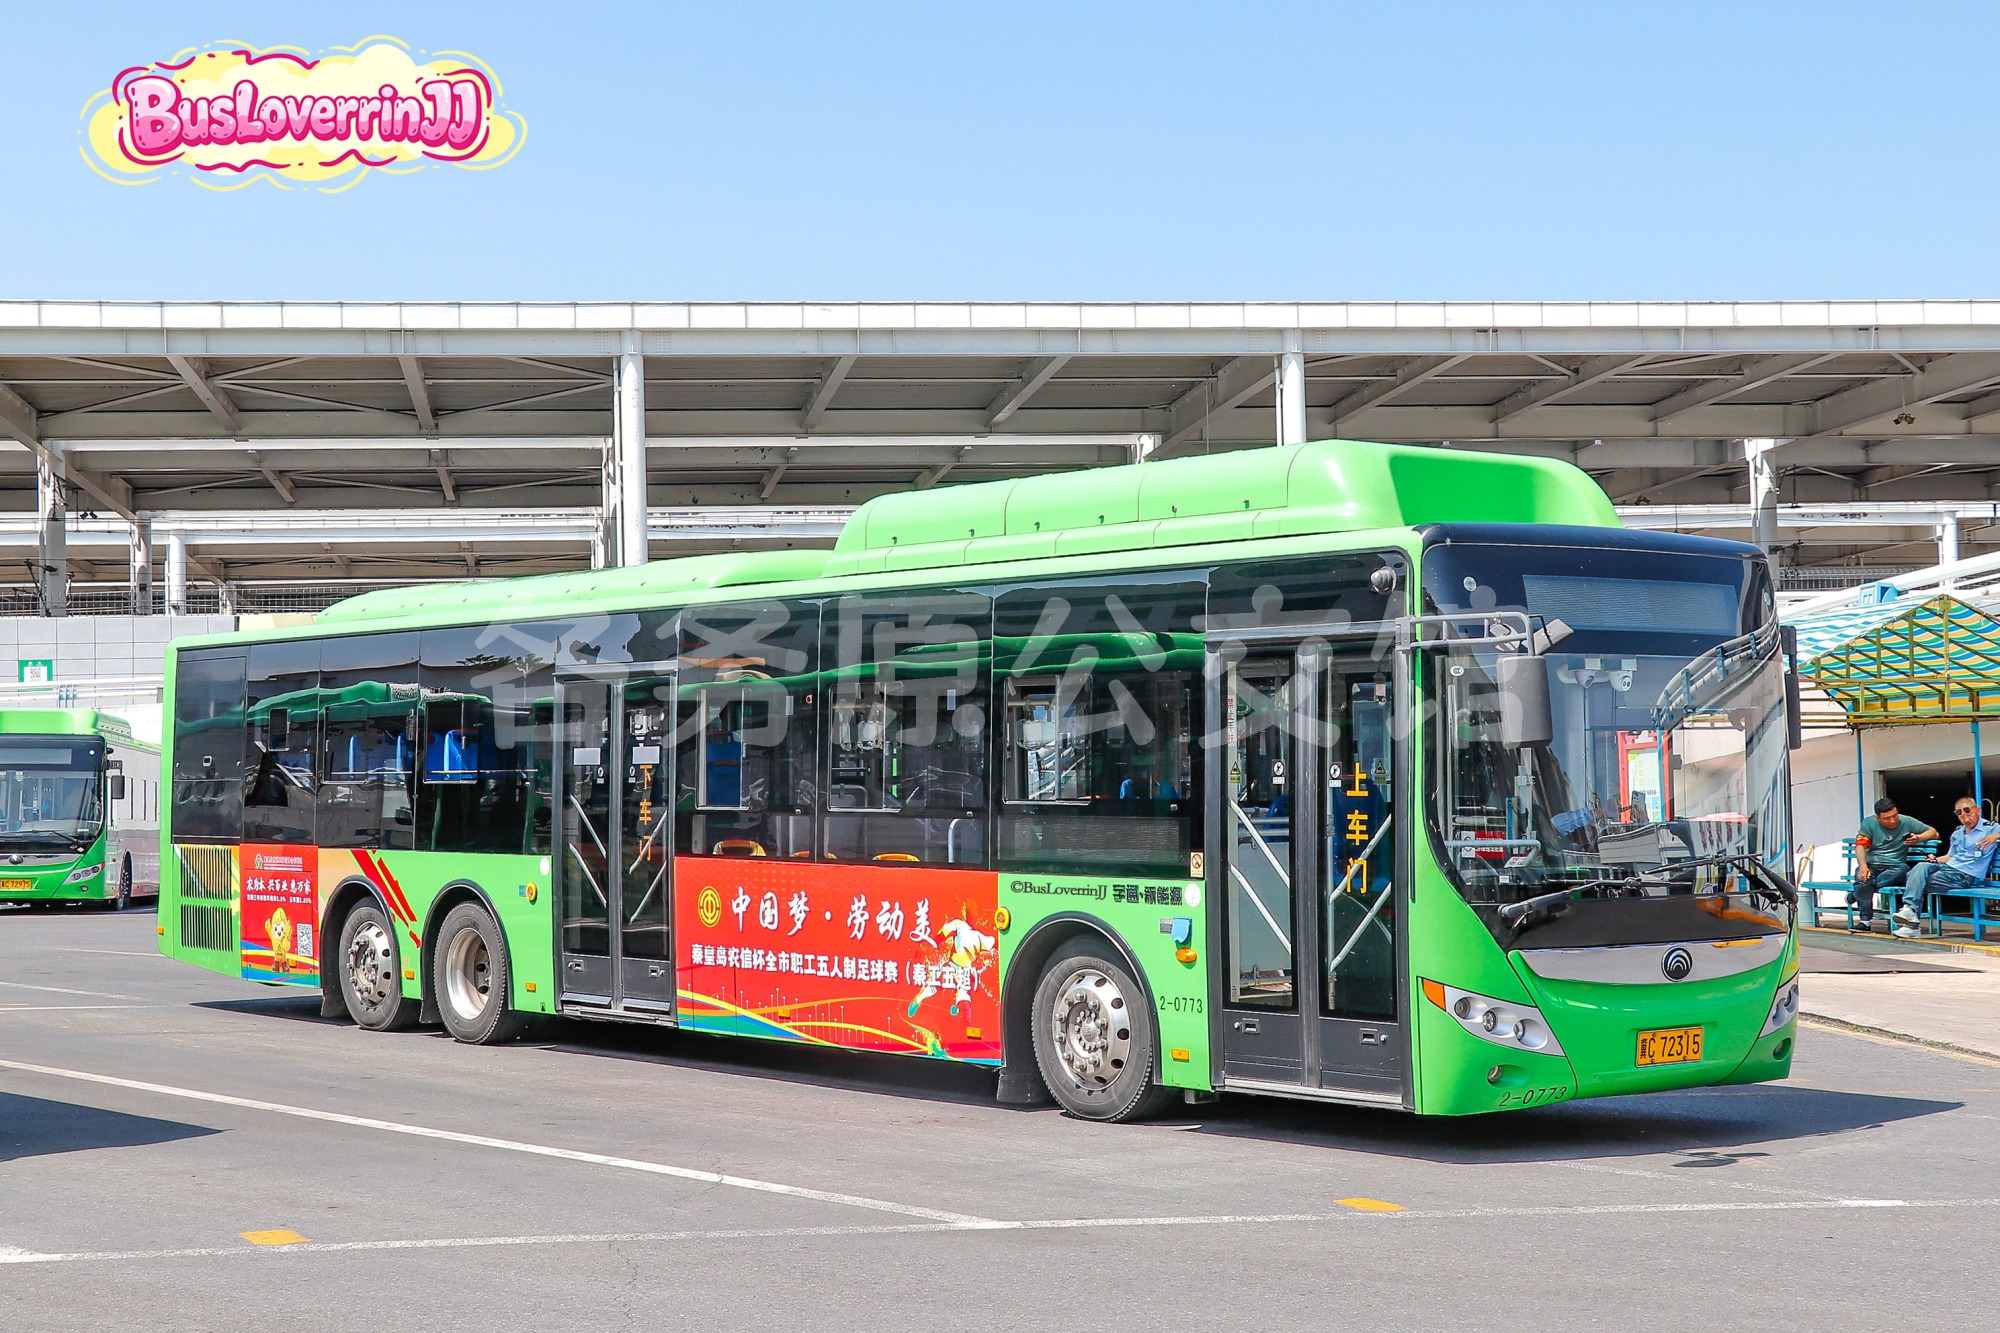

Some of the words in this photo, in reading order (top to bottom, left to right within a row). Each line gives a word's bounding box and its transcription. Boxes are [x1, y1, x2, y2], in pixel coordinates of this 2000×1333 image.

[639, 764, 653, 861] 下车门
[1346, 762, 1369, 894] 上车门
[730, 886, 939, 948] 中国梦·劳动美
[1160, 995, 1203, 1014] 2-0773
[1498, 1086, 1568, 1107] 2-0773
